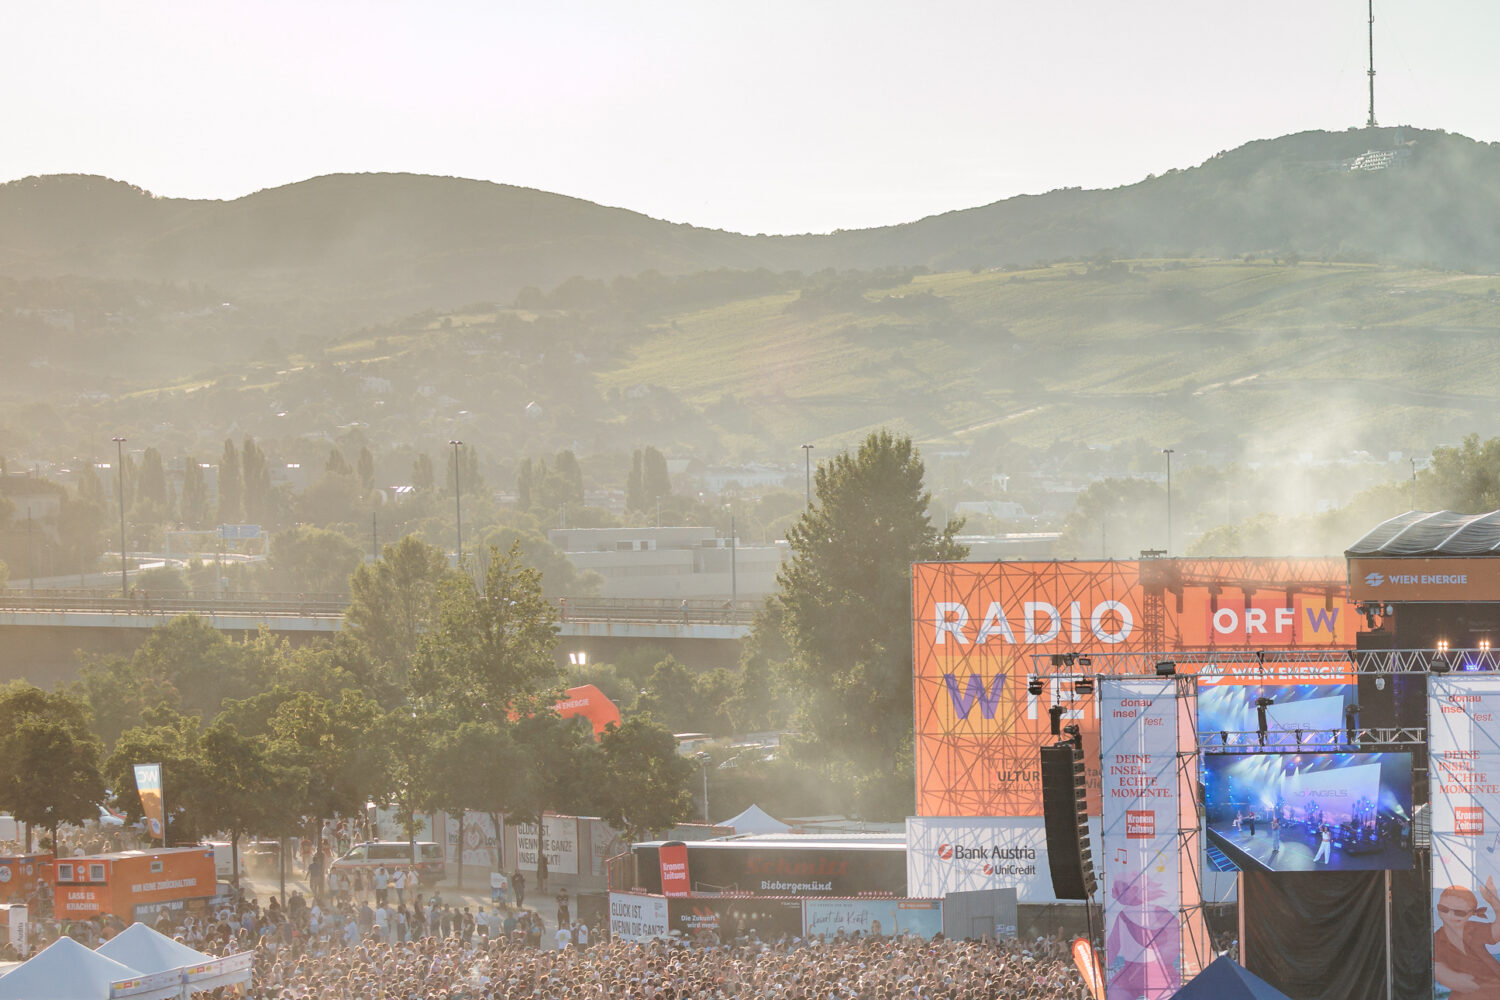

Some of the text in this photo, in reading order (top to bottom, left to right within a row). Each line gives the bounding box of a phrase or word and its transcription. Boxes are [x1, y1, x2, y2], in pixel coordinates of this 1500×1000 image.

[1389, 574, 1467, 585] WIEN ENERGIE
[935, 600, 1133, 644] RADIO
[1213, 608, 1340, 634] ORF W
[1232, 666, 1345, 680] WIEN ENERGIE
[1121, 698, 1152, 708] donau
[1448, 694, 1481, 703] donau
[1113, 709, 1137, 718] insel
[1440, 704, 1466, 713] insel
[1116, 755, 1151, 764] DEINE
[1444, 750, 1480, 760] DEINE
[1110, 766, 1147, 775] INSEL.
[1438, 761, 1475, 771] INSEL.
[1119, 777, 1158, 786] ECHTE
[1447, 773, 1487, 783] ECHTE
[1111, 788, 1173, 798] MOMENTE.
[1127, 813, 1154, 824] Kronen
[1455, 810, 1482, 820] Kronen
[1127, 825, 1154, 834] Zeitung
[1455, 821, 1482, 831] Zeitung
[955, 845, 1036, 860] Bank Austria
[995, 864, 1036, 875] UniCredit
[761, 880, 832, 894] Biebergemünd
[632, 922, 642, 936] DIE
